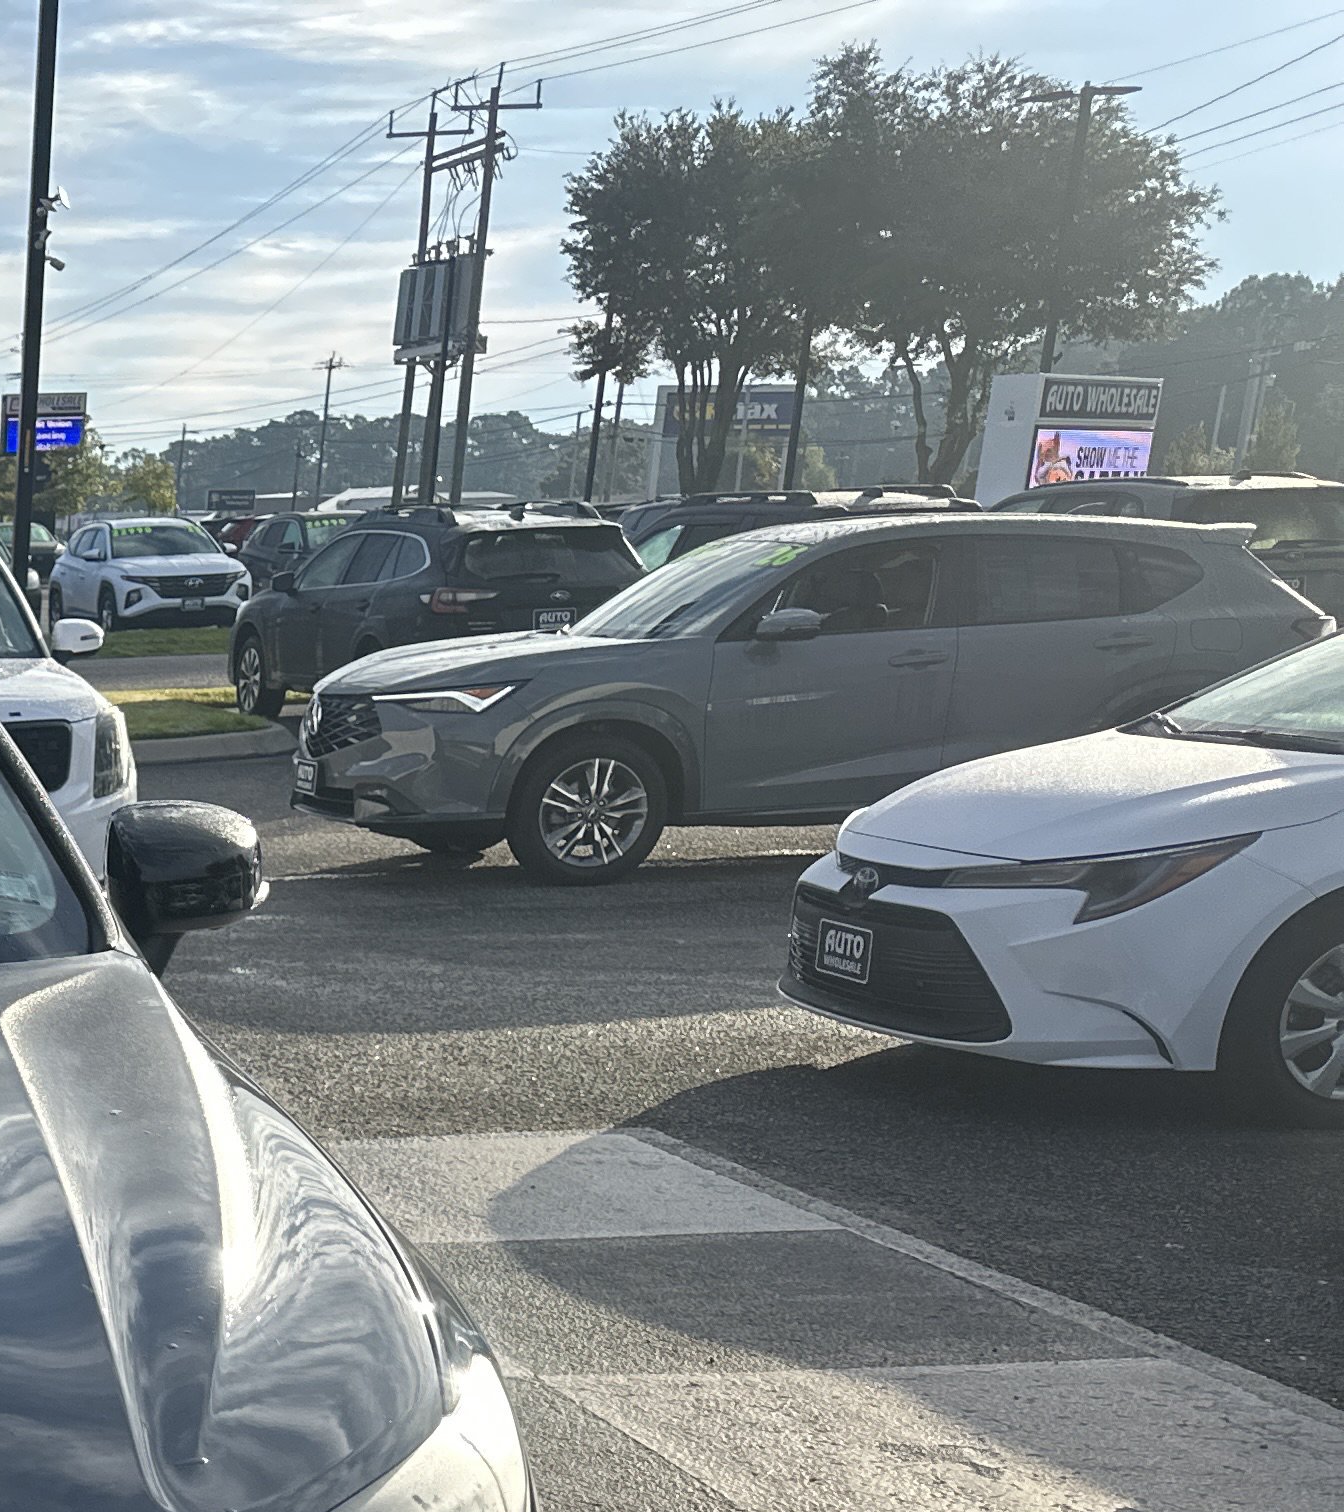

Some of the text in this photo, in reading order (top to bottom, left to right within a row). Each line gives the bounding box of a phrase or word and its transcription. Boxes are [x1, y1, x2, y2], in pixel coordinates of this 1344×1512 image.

[1046, 385, 1158, 415] AUTO WHOLESALE
[1076, 446, 1107, 468] SHOW
[539, 611, 571, 624] AUTO
[824, 929, 865, 959] AUTO
